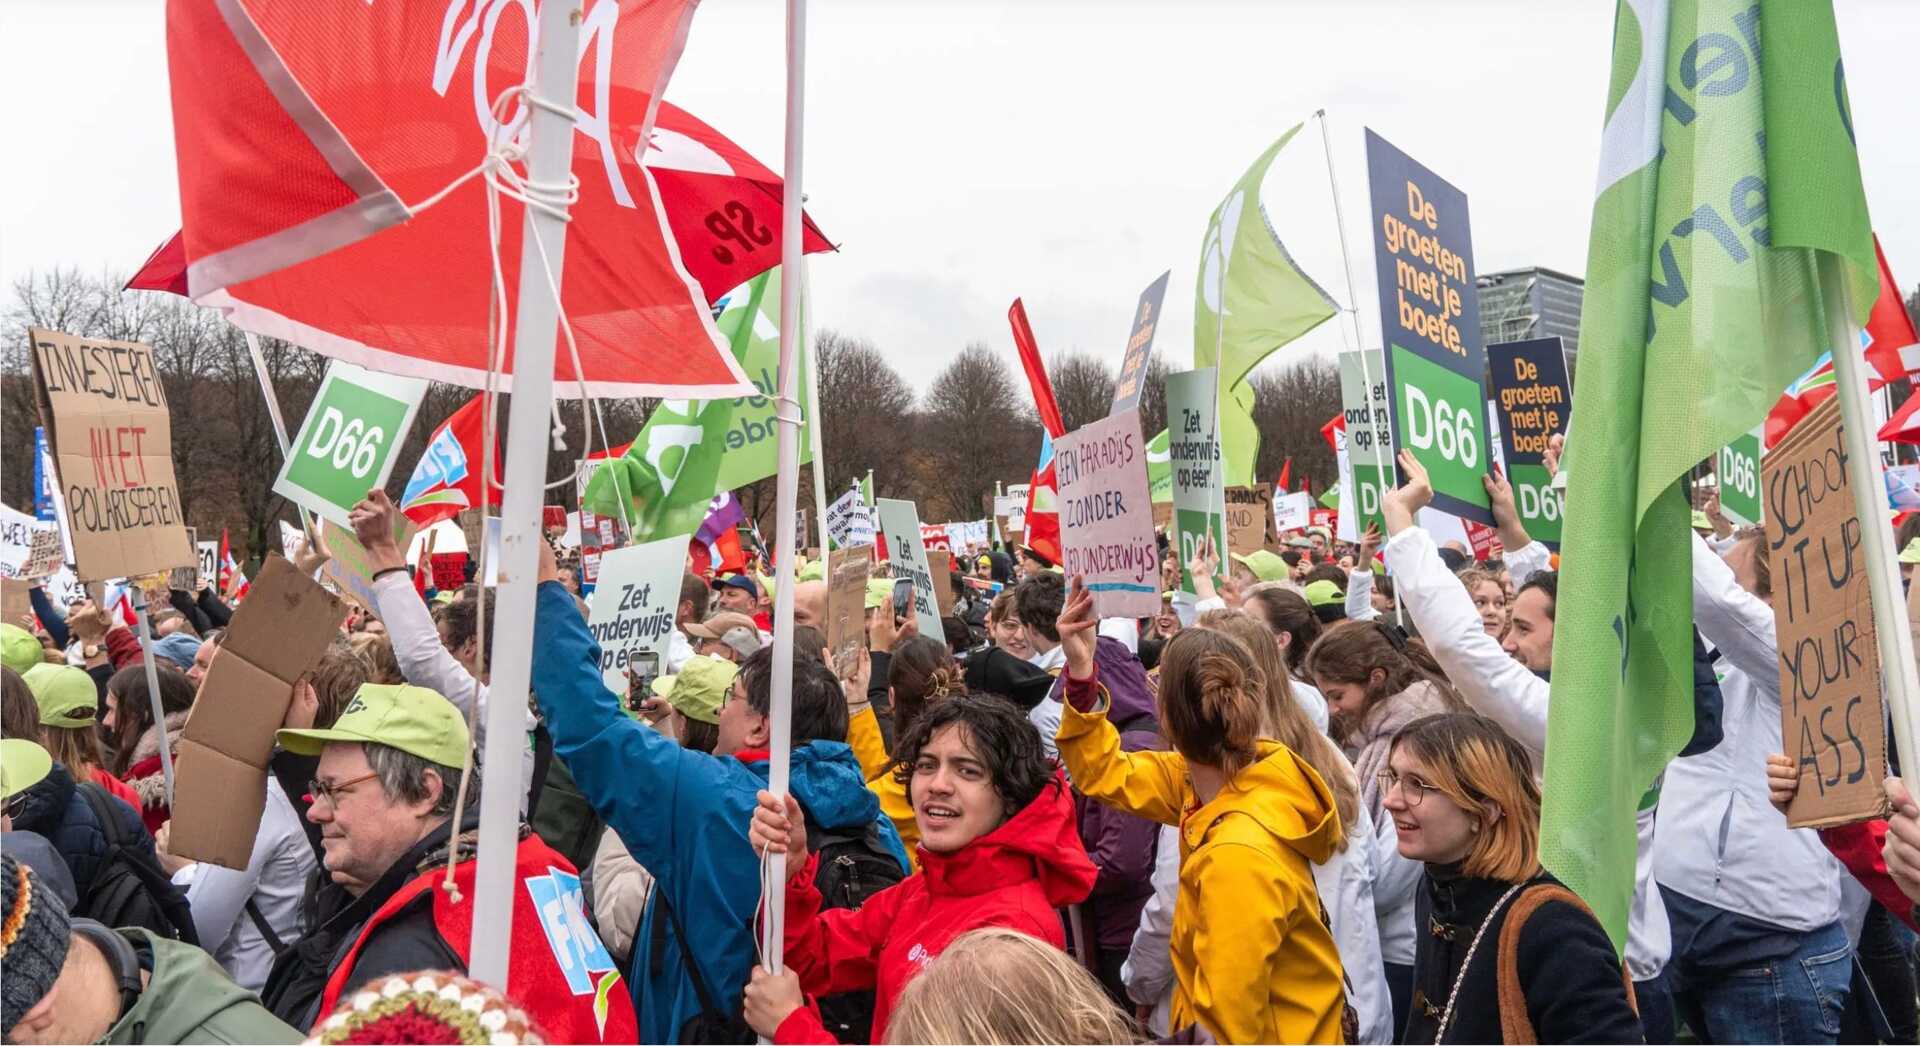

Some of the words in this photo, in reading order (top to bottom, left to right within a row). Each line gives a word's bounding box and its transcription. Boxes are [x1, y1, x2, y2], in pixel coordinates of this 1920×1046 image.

[1408, 180, 1438, 229] De
[1383, 213, 1467, 285] groeten
[1396, 258, 1440, 307] met
[1441, 274, 1462, 321] je
[1398, 288, 1467, 357] boete.
[1514, 358, 1537, 381] De
[1182, 408, 1201, 434] Zet
[1501, 384, 1563, 411] groeten
[1510, 407, 1541, 429] met
[1544, 407, 1559, 433] je
[306, 406, 384, 479] D66
[1170, 437, 1220, 462] onderwis
[1355, 431, 1372, 451] op
[1404, 383, 1478, 469] D66
[1513, 430, 1552, 453] boet
[90, 427, 146, 489] NIET
[1178, 467, 1191, 493] op
[1723, 445, 1756, 499] D66
[1067, 492, 1127, 527] ZONDER
[1784, 537, 1810, 624] IT
[1822, 516, 1860, 589] UP
[618, 583, 651, 611] Zet
[1782, 619, 1862, 718] YOUR
[1796, 696, 1866, 797] ASS
